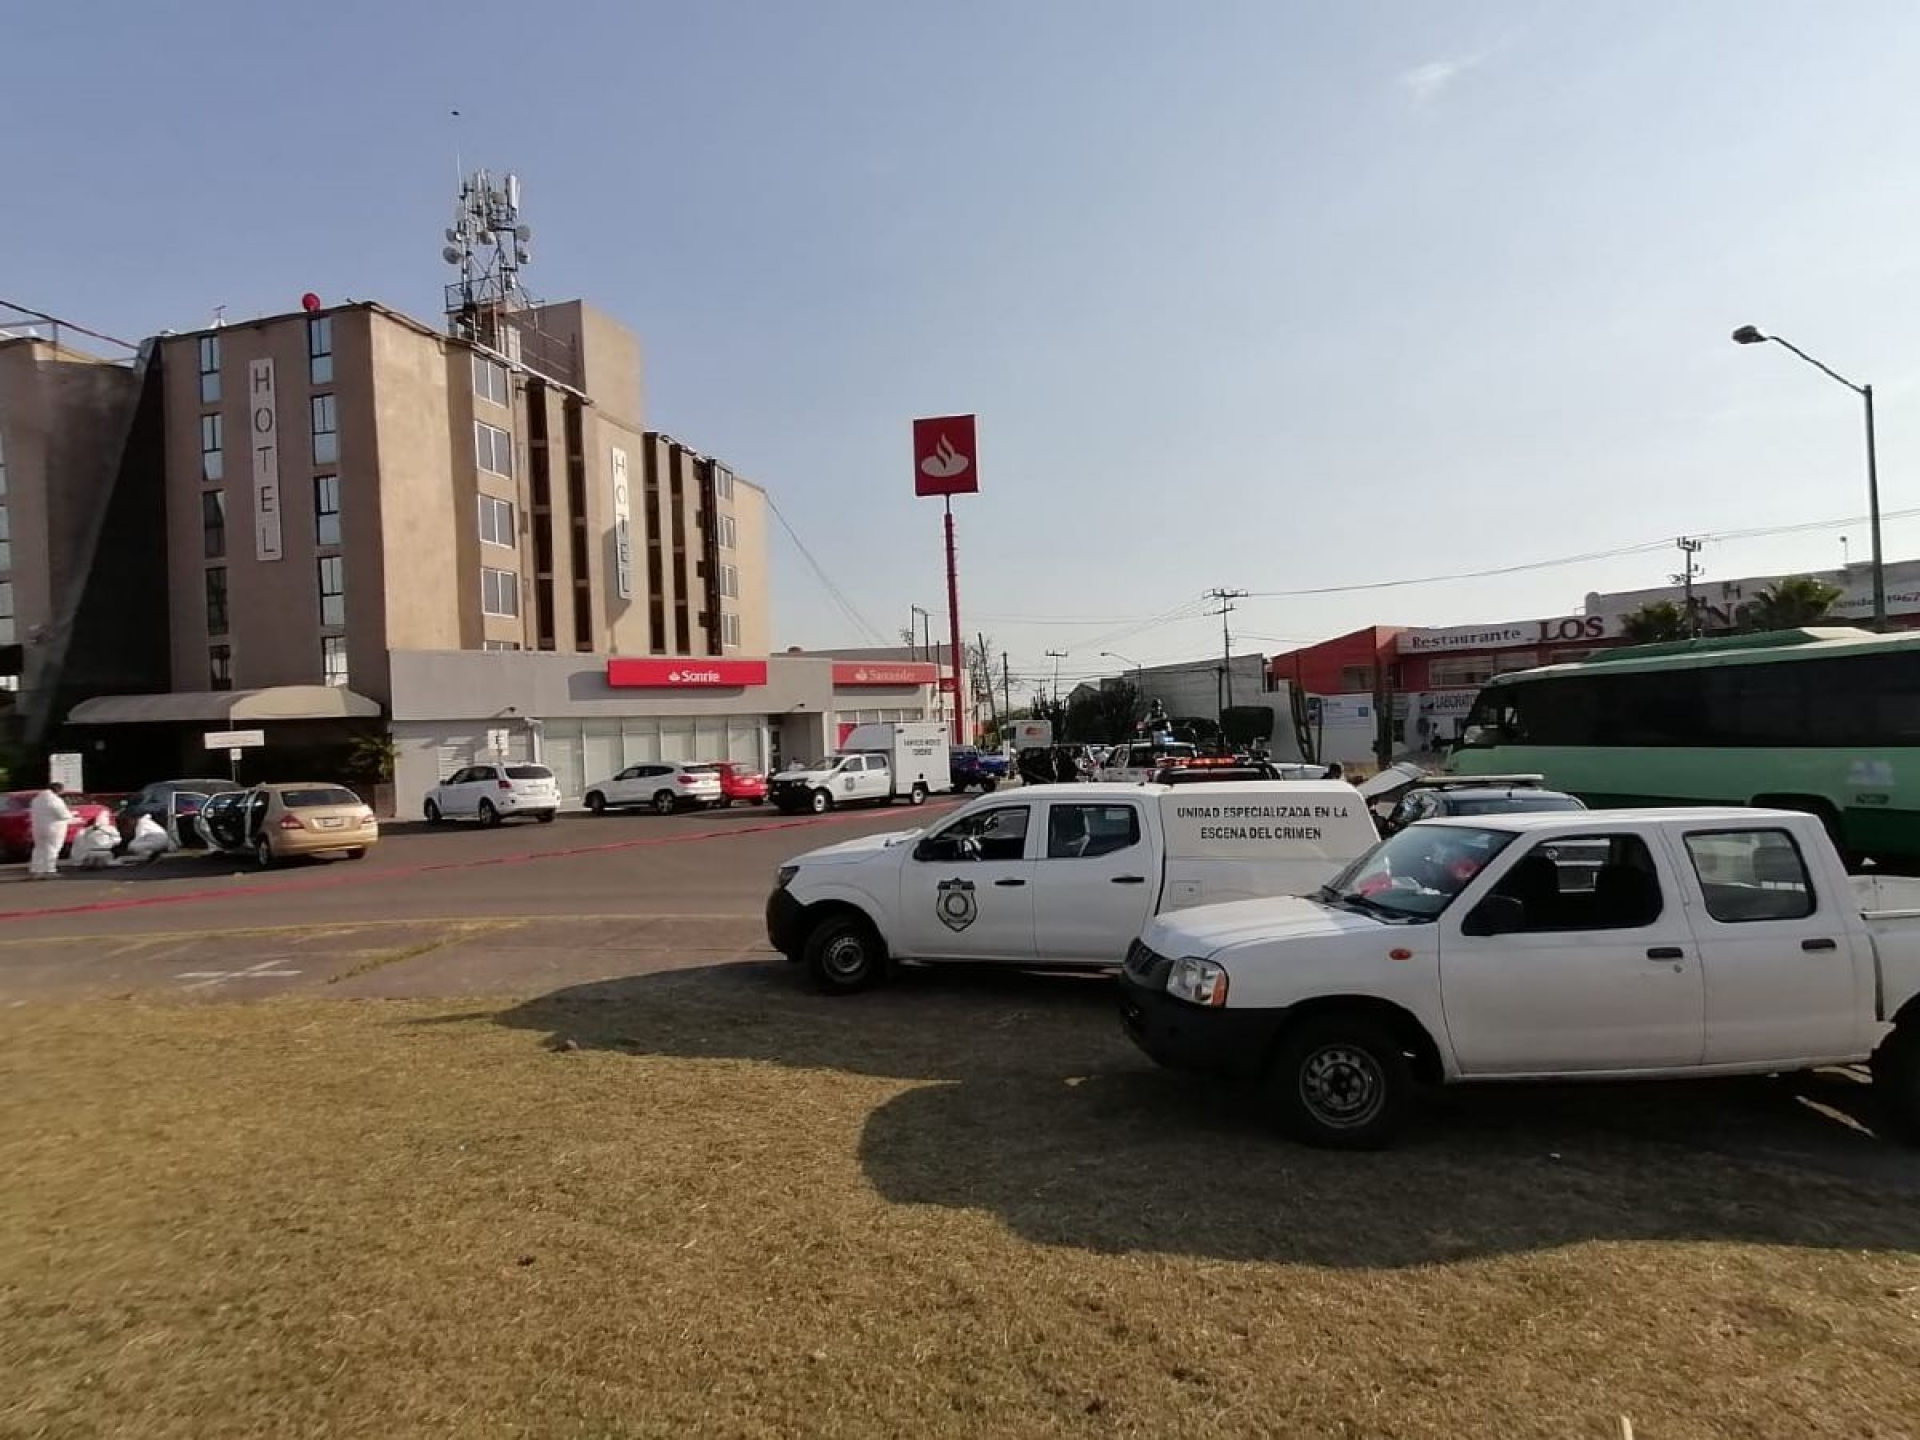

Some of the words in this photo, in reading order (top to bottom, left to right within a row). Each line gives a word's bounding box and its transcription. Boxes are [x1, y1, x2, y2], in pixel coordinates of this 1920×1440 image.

[255, 366, 276, 552] HOTEL
[1413, 629, 1521, 649] Restaurante
[1539, 616, 1604, 641] LOS
[1177, 807, 1220, 818] UNIDAD
[1223, 806, 1311, 818] ESPECIALIZADA
[1315, 806, 1329, 817] EN
[1334, 806, 1348, 818] LA
[1201, 827, 1247, 839] ESCENA
[1249, 827, 1272, 839] DEL
[1275, 827, 1321, 839] CRIMEN
